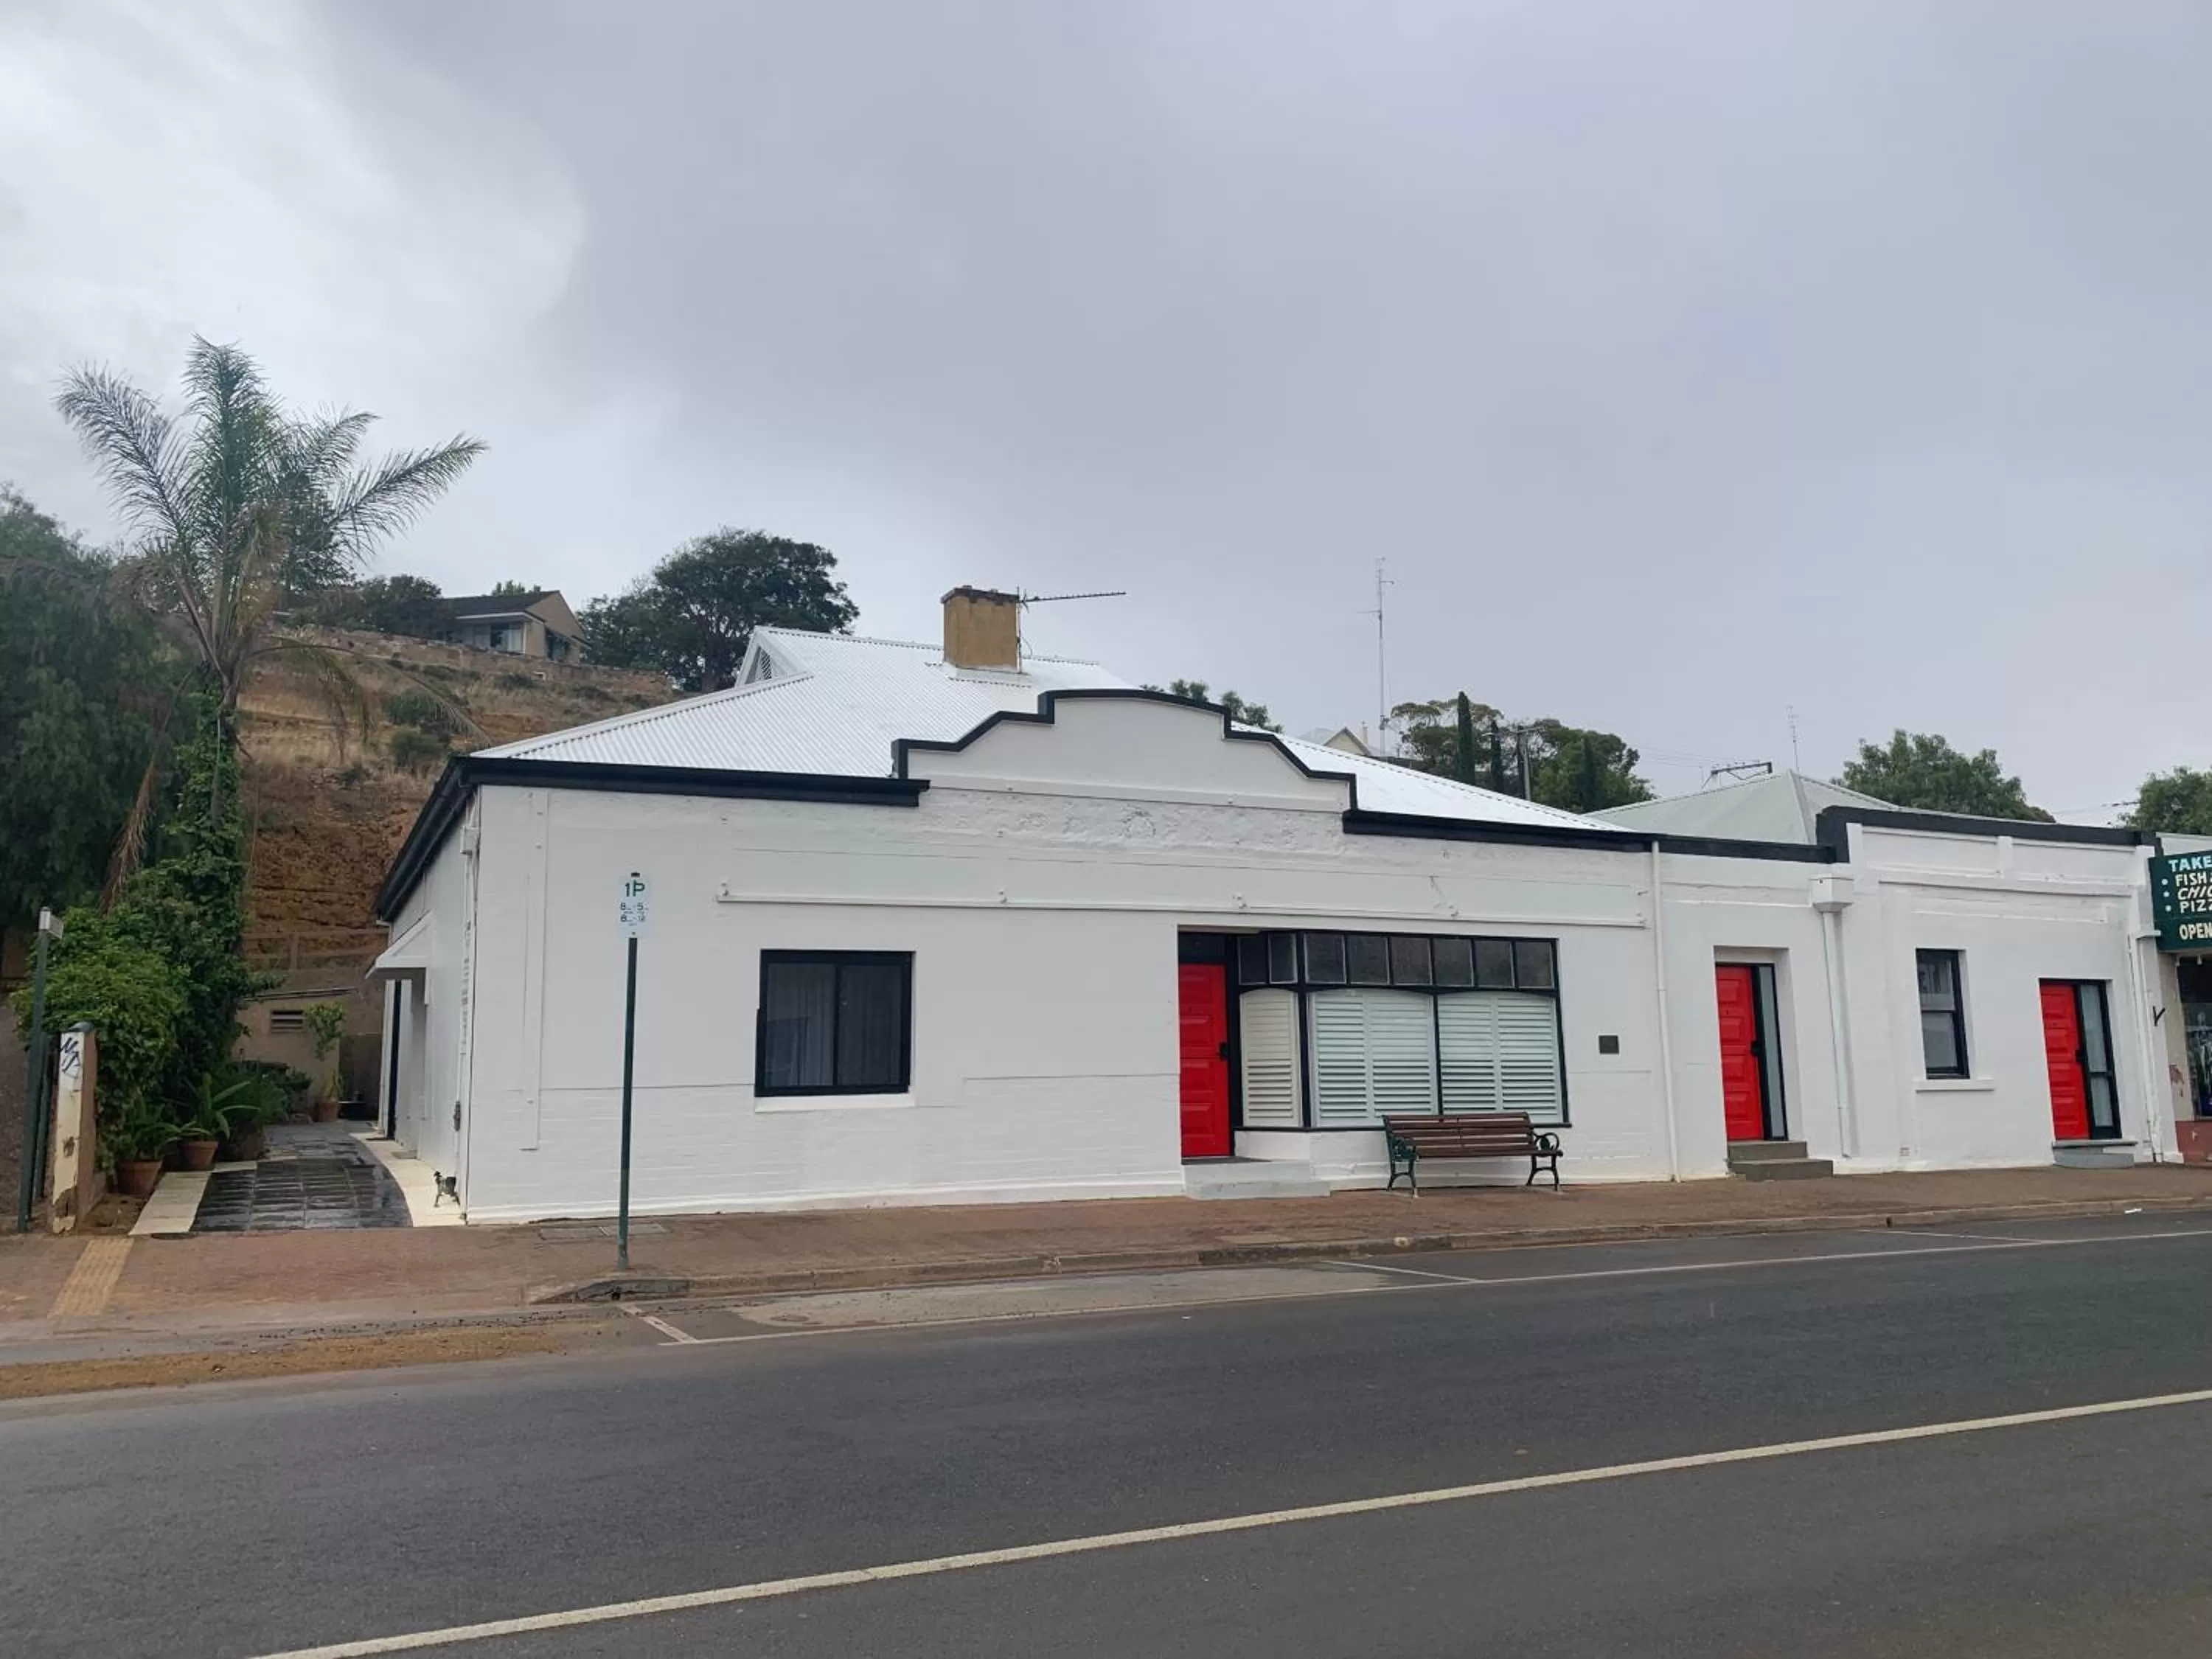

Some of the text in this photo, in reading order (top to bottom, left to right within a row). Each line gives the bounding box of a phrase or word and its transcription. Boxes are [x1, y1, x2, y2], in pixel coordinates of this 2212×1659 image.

[2168, 855, 2212, 872] TAKE
[2175, 871, 2207, 887] FISH
[625, 880, 645, 897] 1P
[2179, 922, 2212, 941] OPEN
